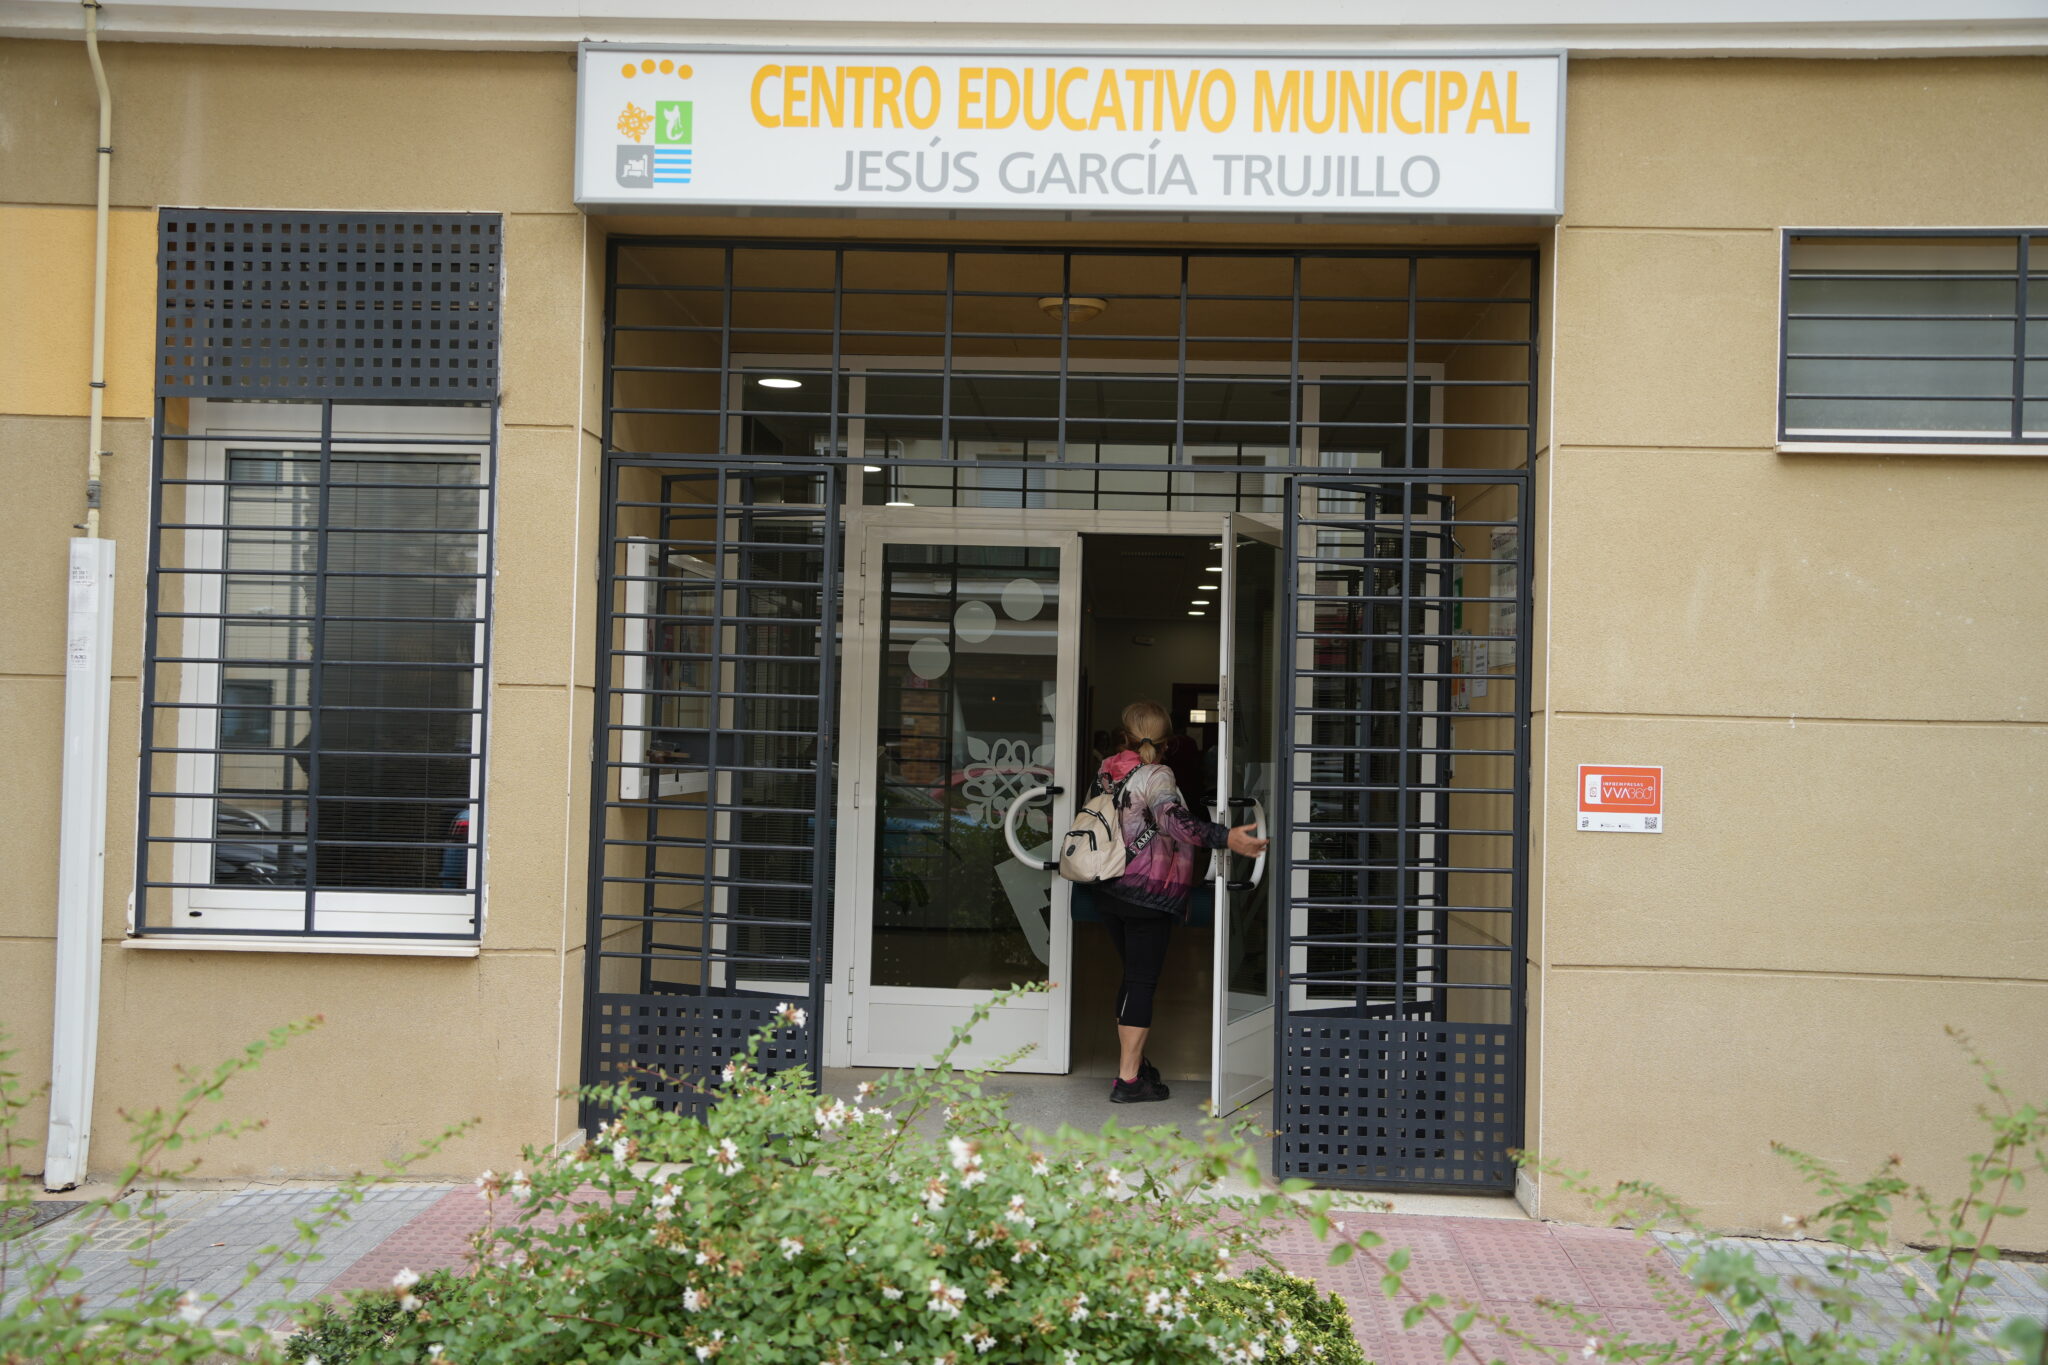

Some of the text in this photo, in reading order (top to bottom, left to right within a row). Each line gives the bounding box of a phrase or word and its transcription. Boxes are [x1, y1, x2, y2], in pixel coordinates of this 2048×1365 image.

[751, 63, 1532, 135] CENTRO EDUCATIVO MUNICIPAL
[834, 136, 1441, 198] JESÚS GARCÍA TRUJILLO
